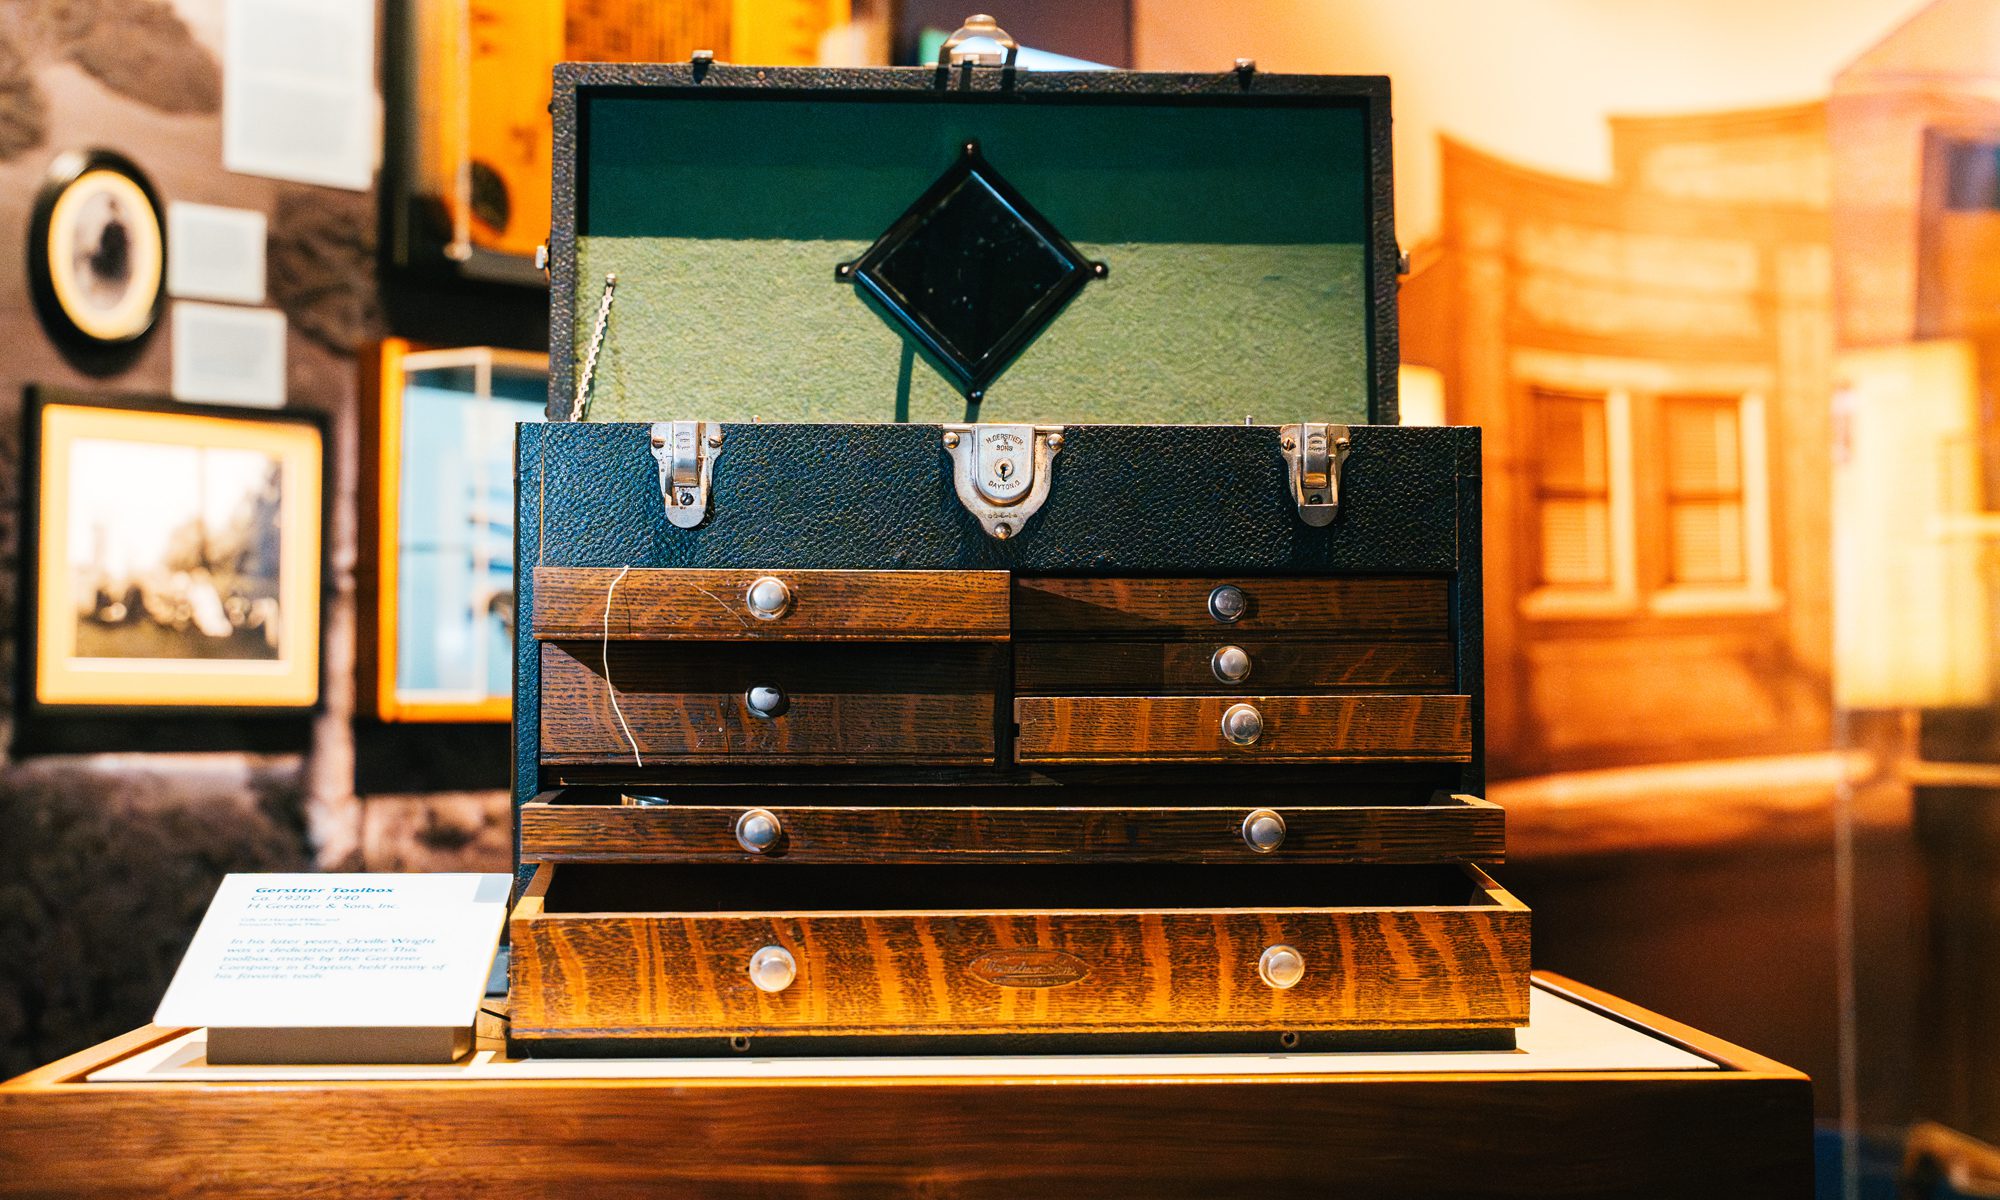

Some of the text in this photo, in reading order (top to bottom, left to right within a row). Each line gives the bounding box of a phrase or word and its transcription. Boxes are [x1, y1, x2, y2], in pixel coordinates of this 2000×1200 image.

[391, 938, 437, 946] Wright
[319, 955, 336, 963] by
[218, 964, 282, 972] Company
[431, 963, 448, 972] of
[235, 973, 289, 981] favorite
